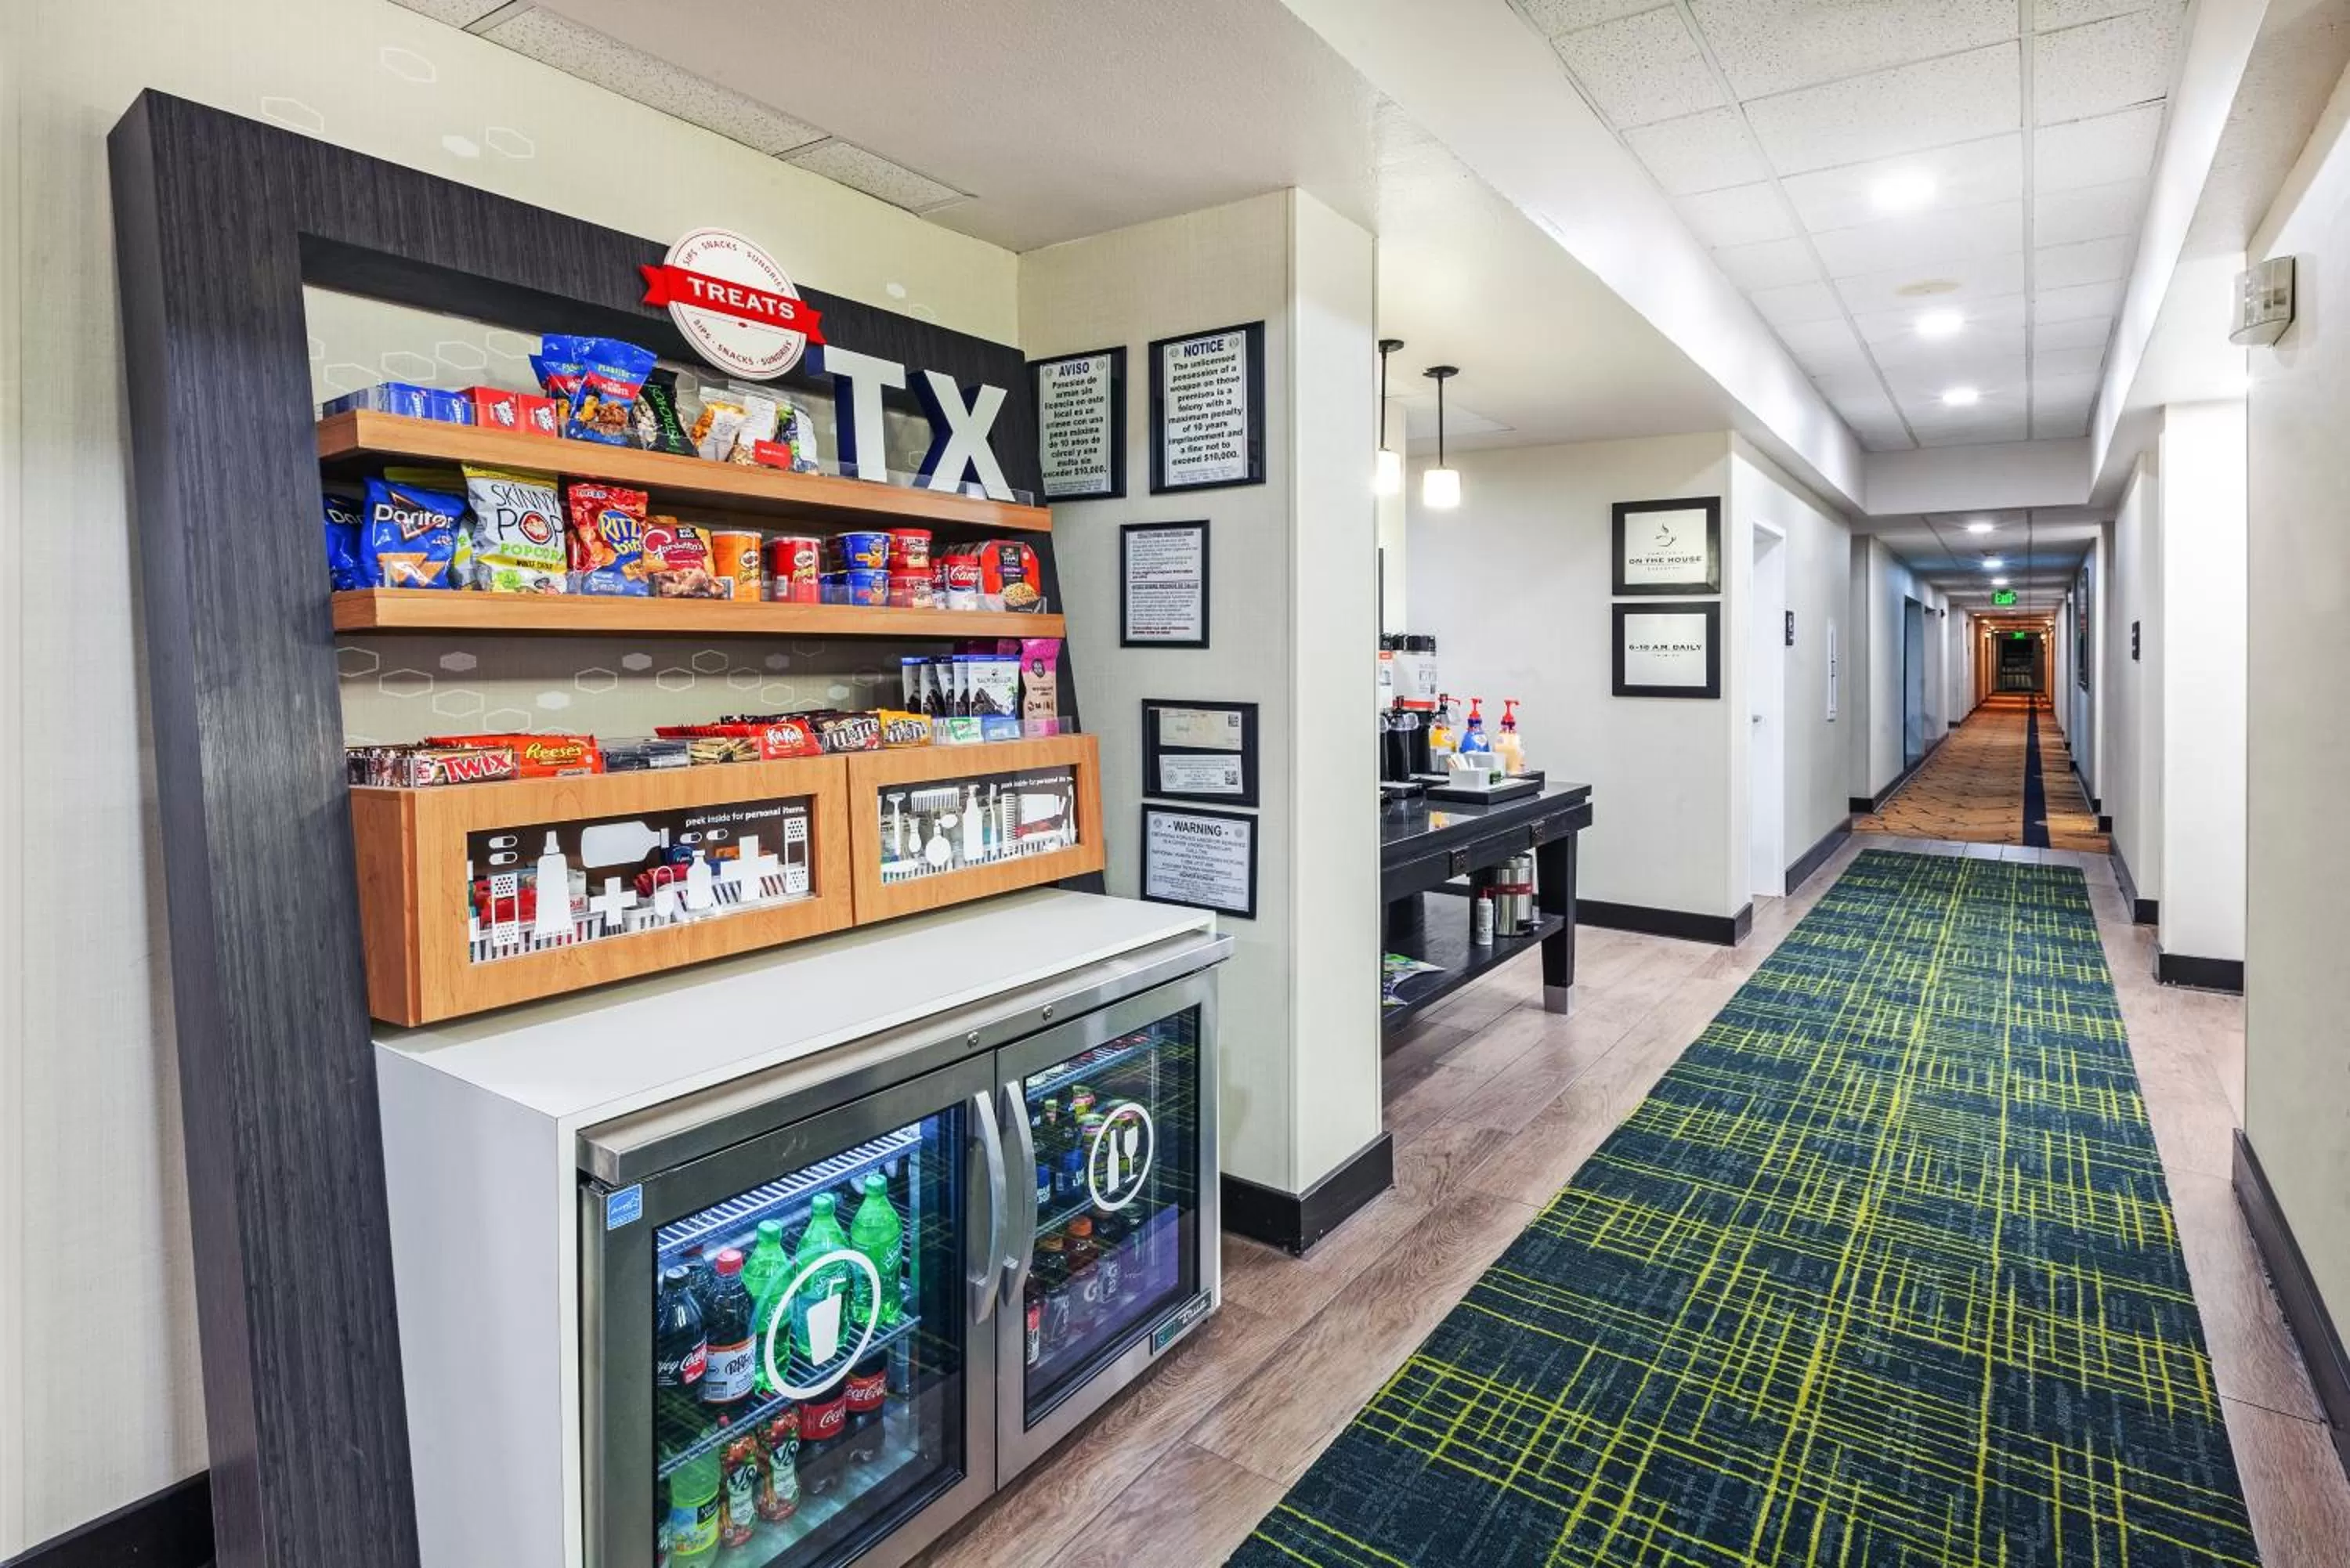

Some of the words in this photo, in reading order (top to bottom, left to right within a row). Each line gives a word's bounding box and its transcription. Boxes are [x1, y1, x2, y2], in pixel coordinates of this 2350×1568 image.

[701, 240, 738, 251] SNACKS
[686, 276, 796, 320] TREATS
[718, 344, 754, 366] SNACKS
[1184, 338, 1224, 358] NOTICE
[1058, 362, 1090, 377] AVISO
[1173, 363, 1188, 371] The
[1191, 354, 1235, 368] unlicensed
[1173, 369, 1218, 384] possession
[1206, 399, 1224, 407] with
[1054, 409, 1072, 418] local
[1210, 407, 1242, 420] penalty
[1182, 424, 1191, 432] of
[1206, 421, 1228, 431] years
[1227, 428, 1242, 437] and
[1172, 455, 1202, 465] exceed
[497, 508, 565, 547] POP
[601, 515, 642, 540] RITZ
[685, 817, 706, 828] peek
[707, 812, 731, 823] inside
[732, 811, 744, 821] for
[745, 807, 781, 820] personal
[1173, 820, 1222, 836] WARNING
